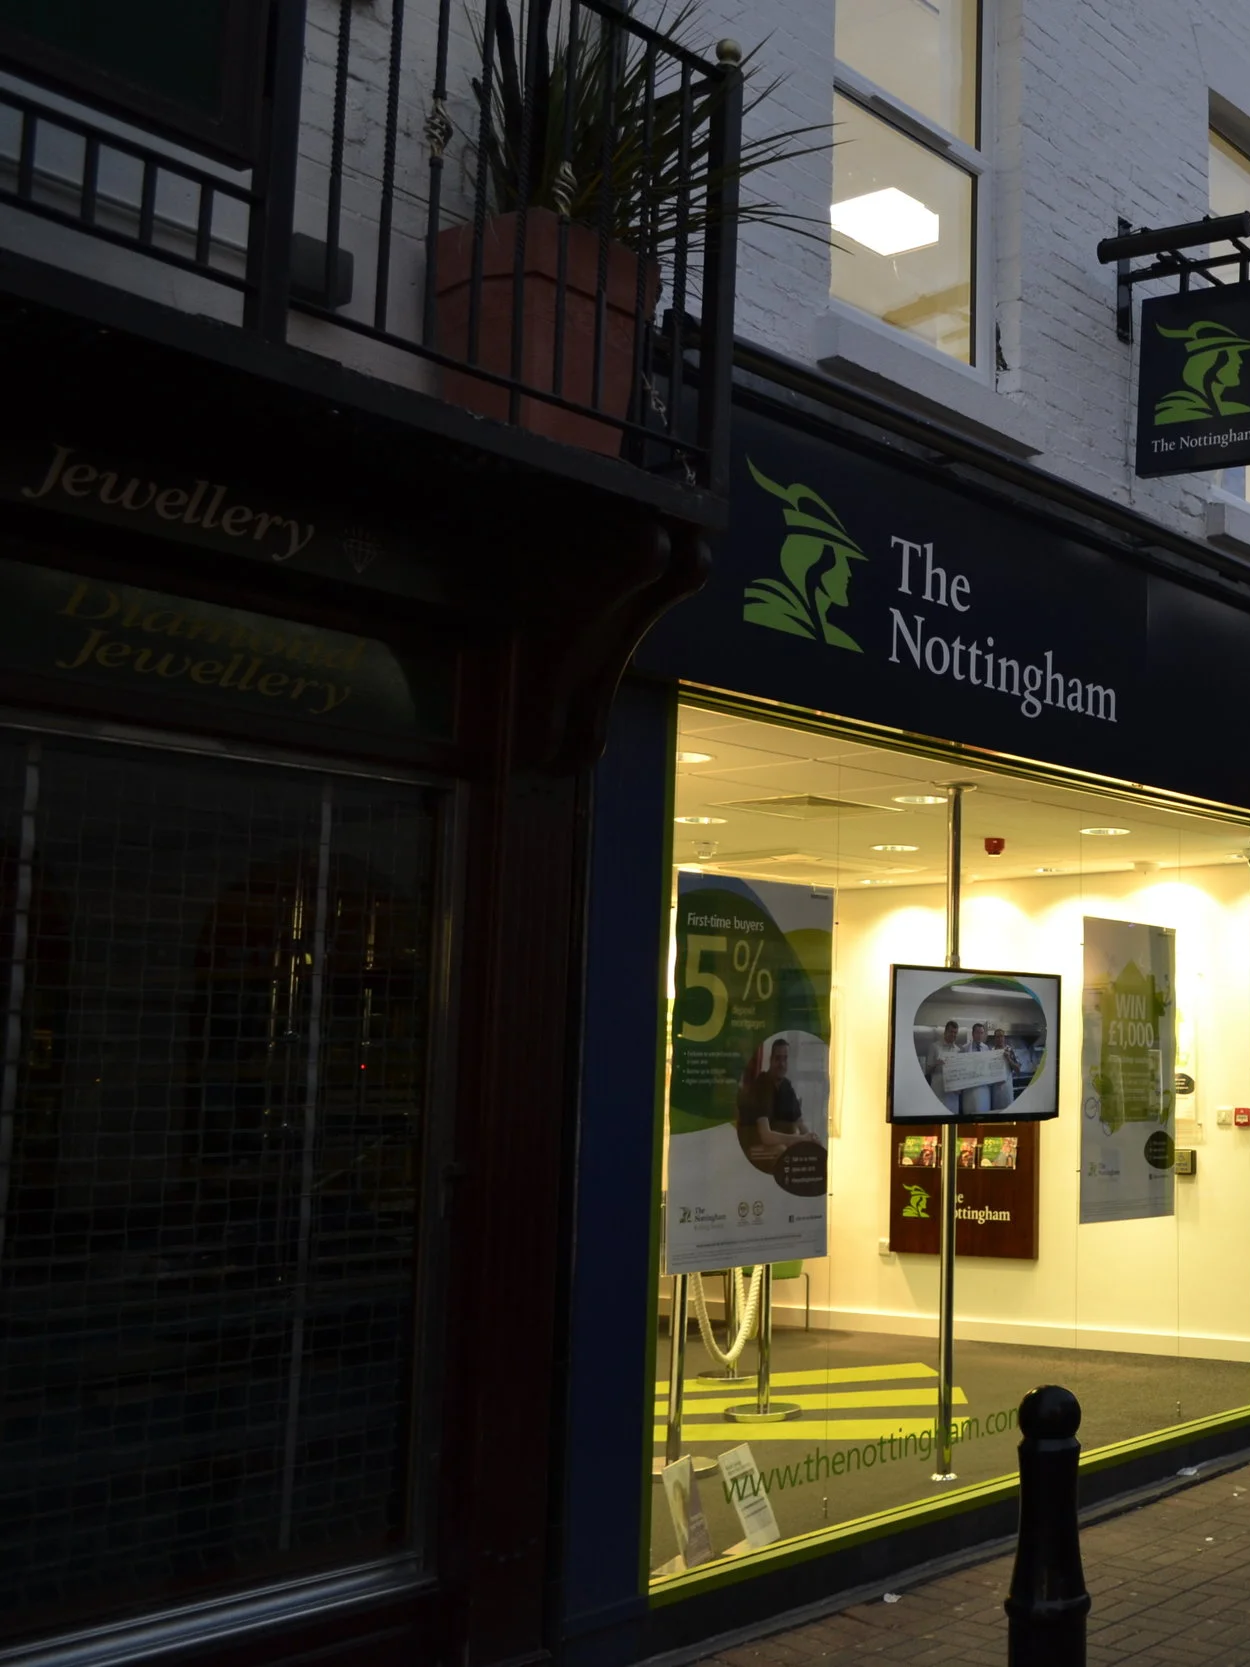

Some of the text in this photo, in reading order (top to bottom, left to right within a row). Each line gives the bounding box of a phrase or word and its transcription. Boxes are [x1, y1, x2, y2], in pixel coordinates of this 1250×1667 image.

[1151, 438, 1176, 453] The
[21, 443, 316, 561] Jewellery
[889, 534, 972, 613] The
[56, 582, 367, 670] Diamond
[888, 606, 1118, 723] Nottingham
[55, 627, 353, 715] Jewellery
[687, 911, 765, 934] First-time buyers
[681, 933, 774, 1043] 5%
[1115, 993, 1147, 1020] WIN
[1107, 1020, 1155, 1050] £1,000
